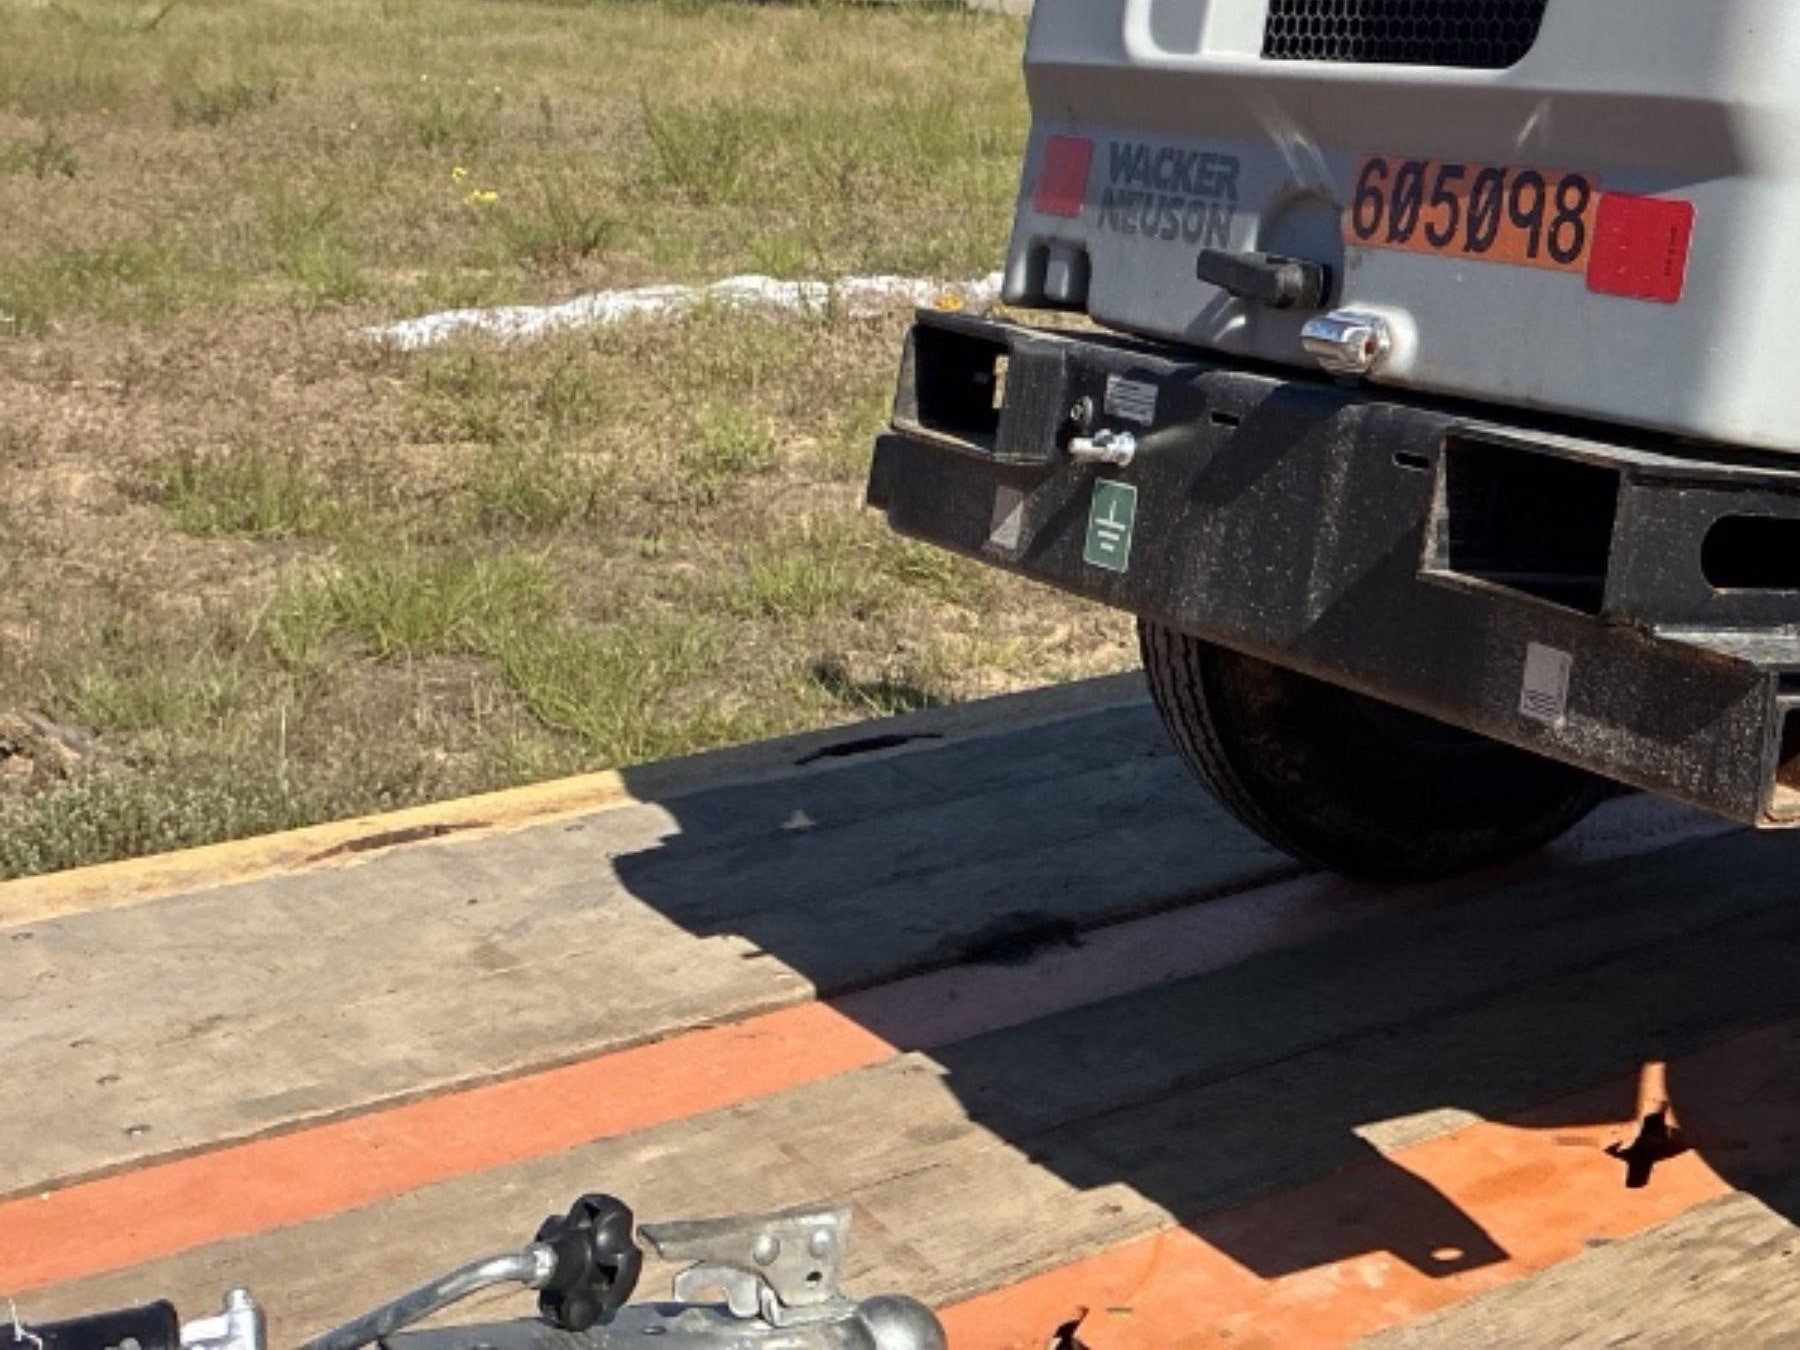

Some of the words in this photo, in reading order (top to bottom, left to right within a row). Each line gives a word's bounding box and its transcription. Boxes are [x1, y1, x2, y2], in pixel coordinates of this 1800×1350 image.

[1108, 140, 1240, 201] WACKER
[1097, 186, 1237, 250] NEUSON
[1352, 158, 1591, 264] 605098
